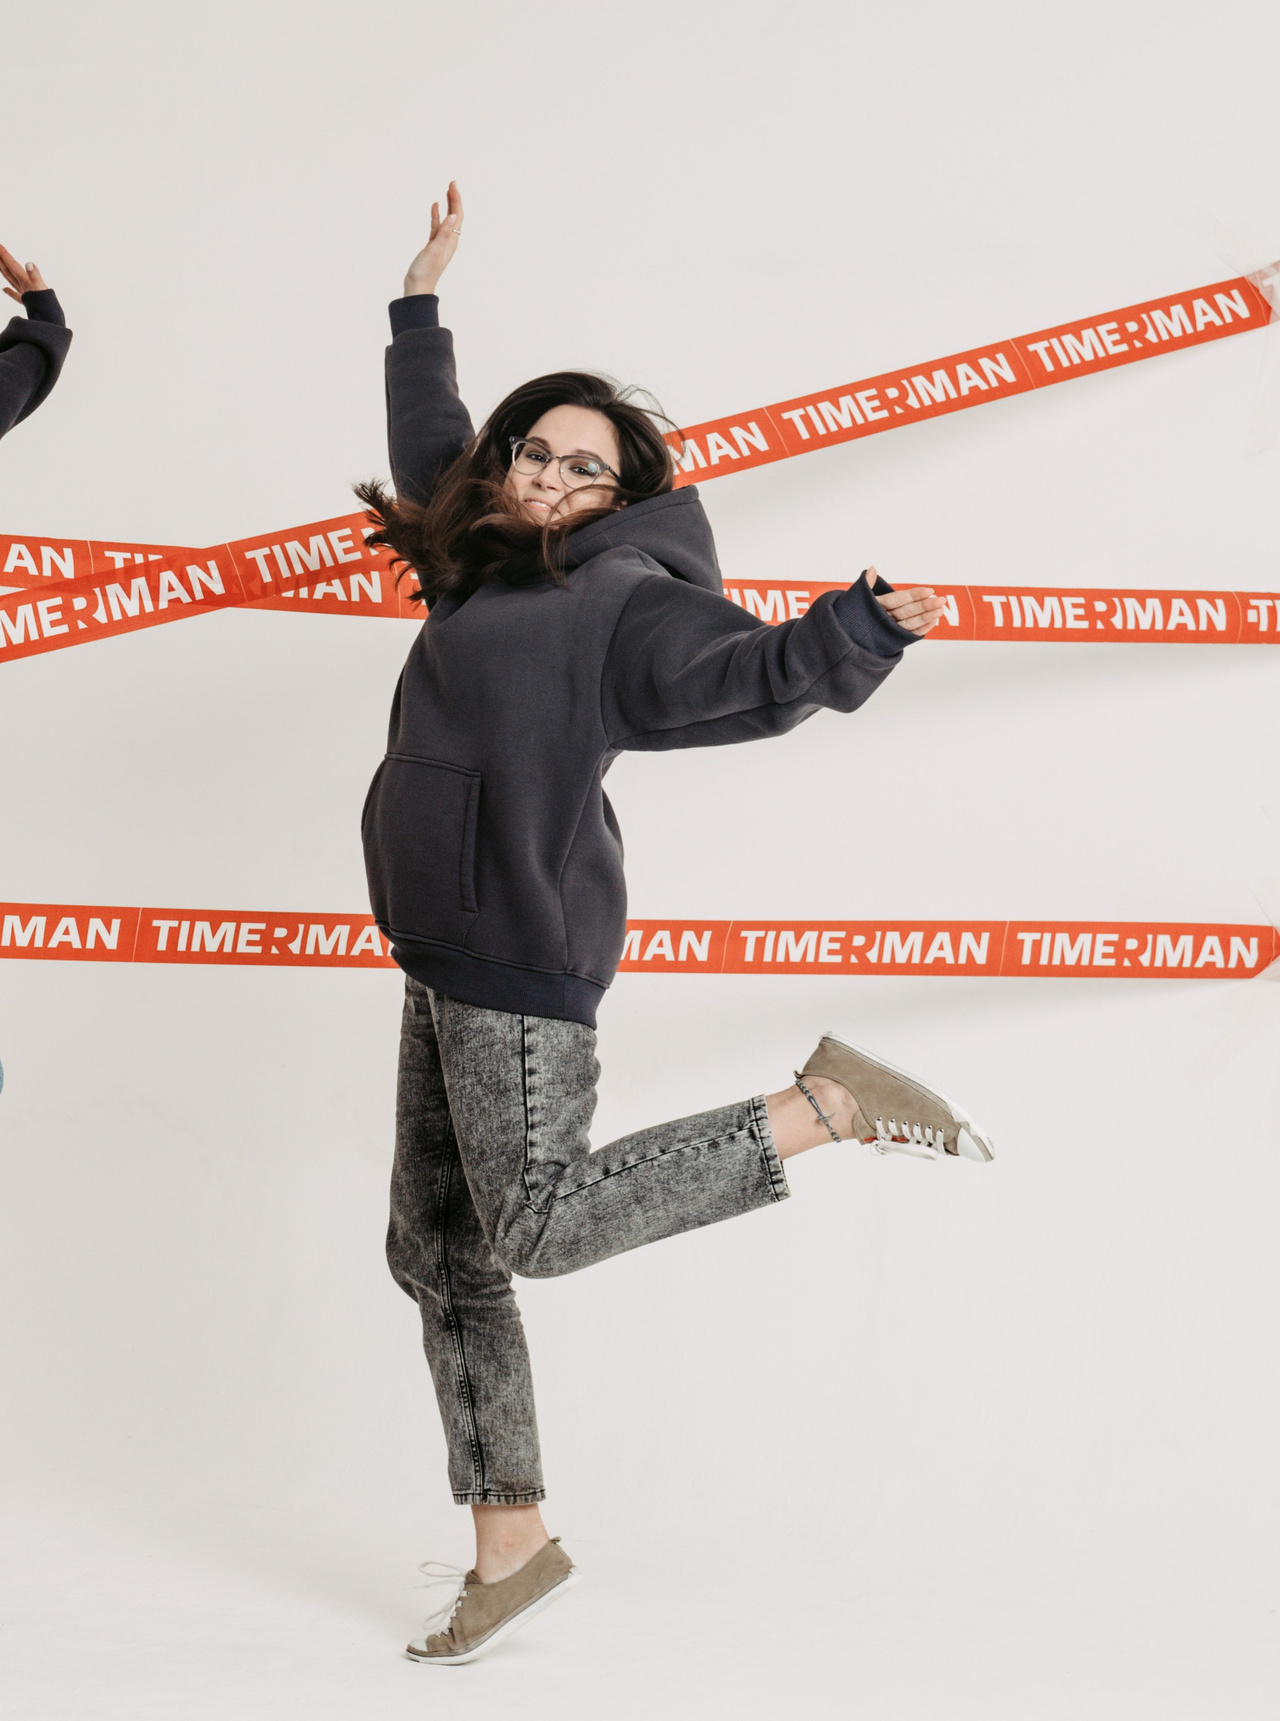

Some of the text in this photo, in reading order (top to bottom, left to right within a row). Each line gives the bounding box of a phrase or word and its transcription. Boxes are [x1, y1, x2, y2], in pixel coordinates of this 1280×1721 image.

[244, 527, 380, 583] TIME
[781, 354, 1017, 440] TIMERMAN
[1027, 289, 1251, 372] TIMERMAN
[982, 595, 1227, 631] TIMERMAN
[152, 919, 395, 957] TIMERMA
[740, 930, 990, 965] TIMERMAN
[1016, 932, 1259, 968] TIMERMAN
